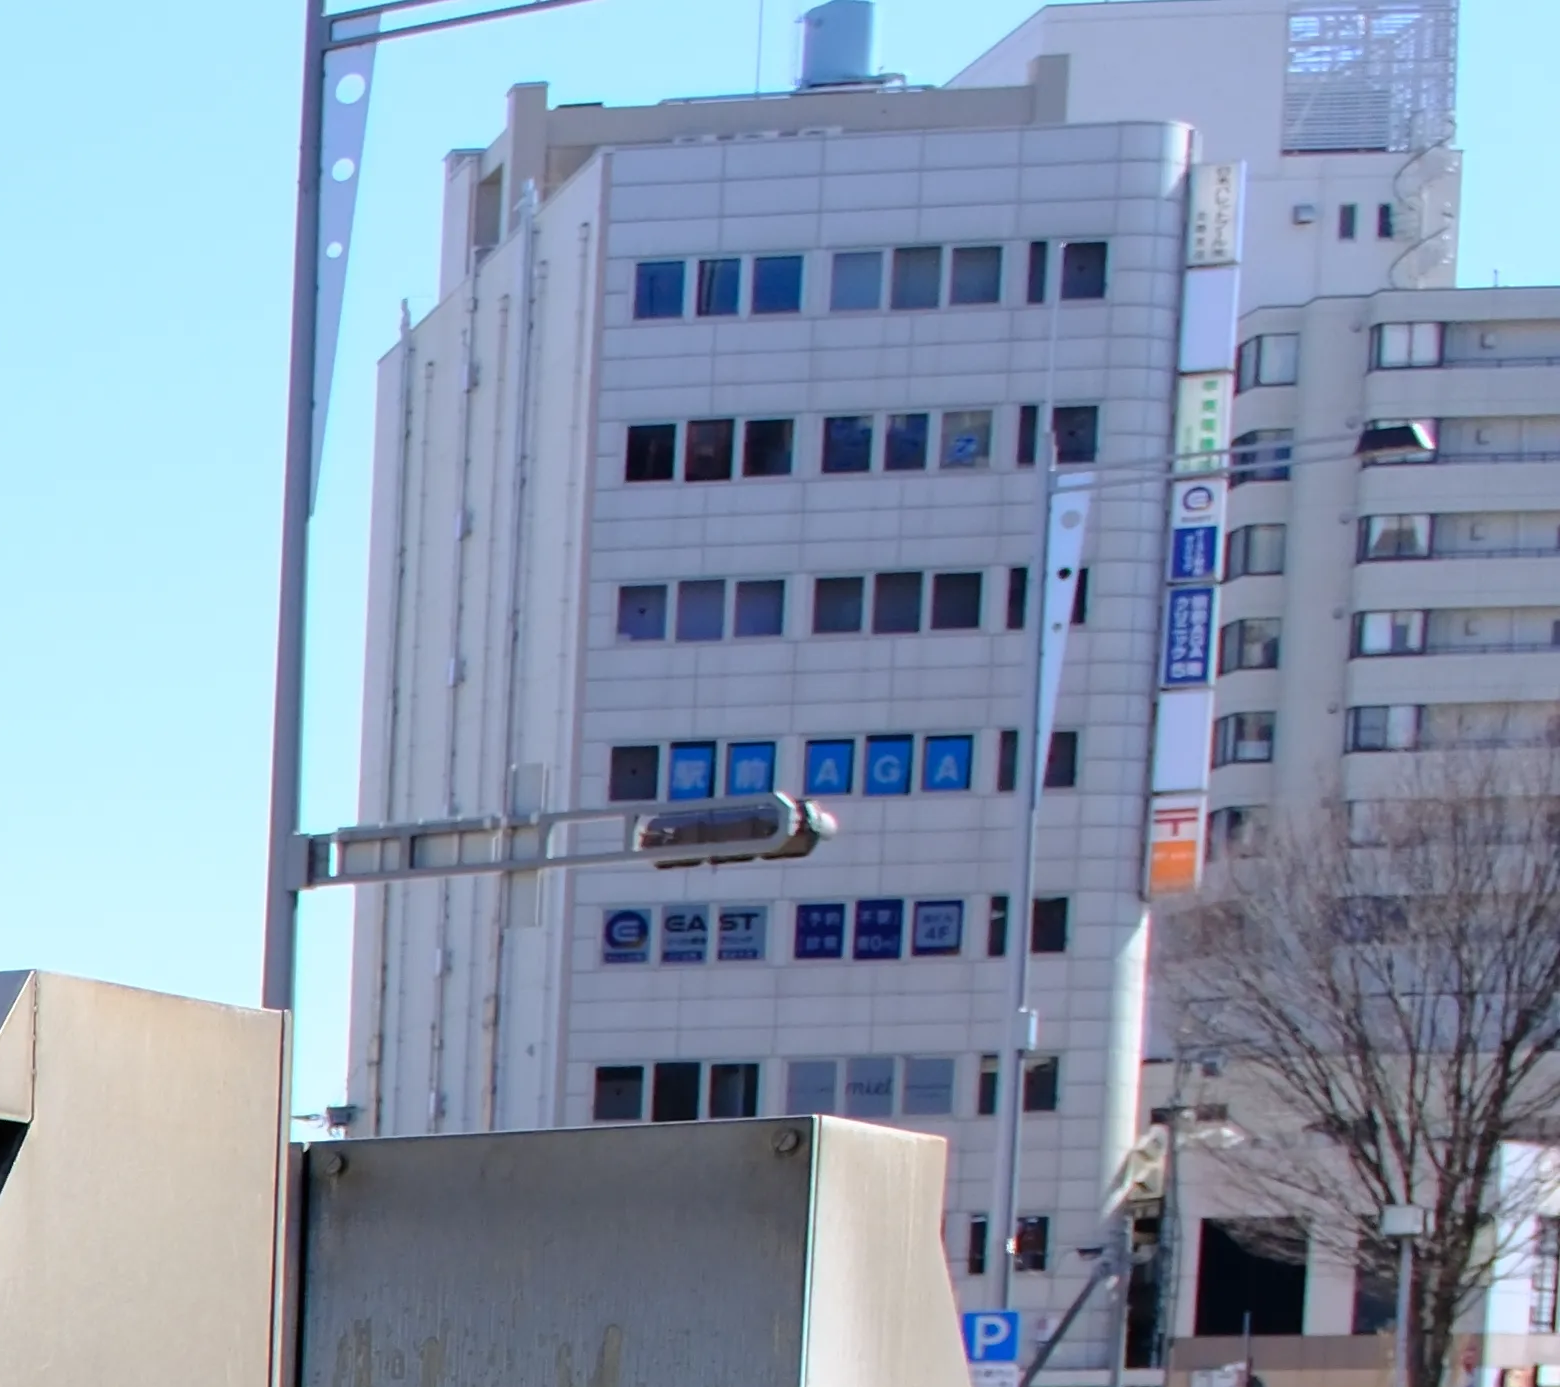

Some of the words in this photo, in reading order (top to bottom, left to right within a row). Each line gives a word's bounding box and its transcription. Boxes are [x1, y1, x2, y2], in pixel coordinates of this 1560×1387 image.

[814, 754, 959, 787] AGA
[664, 912, 760, 933] EAST
[973, 1315, 1012, 1360] P
